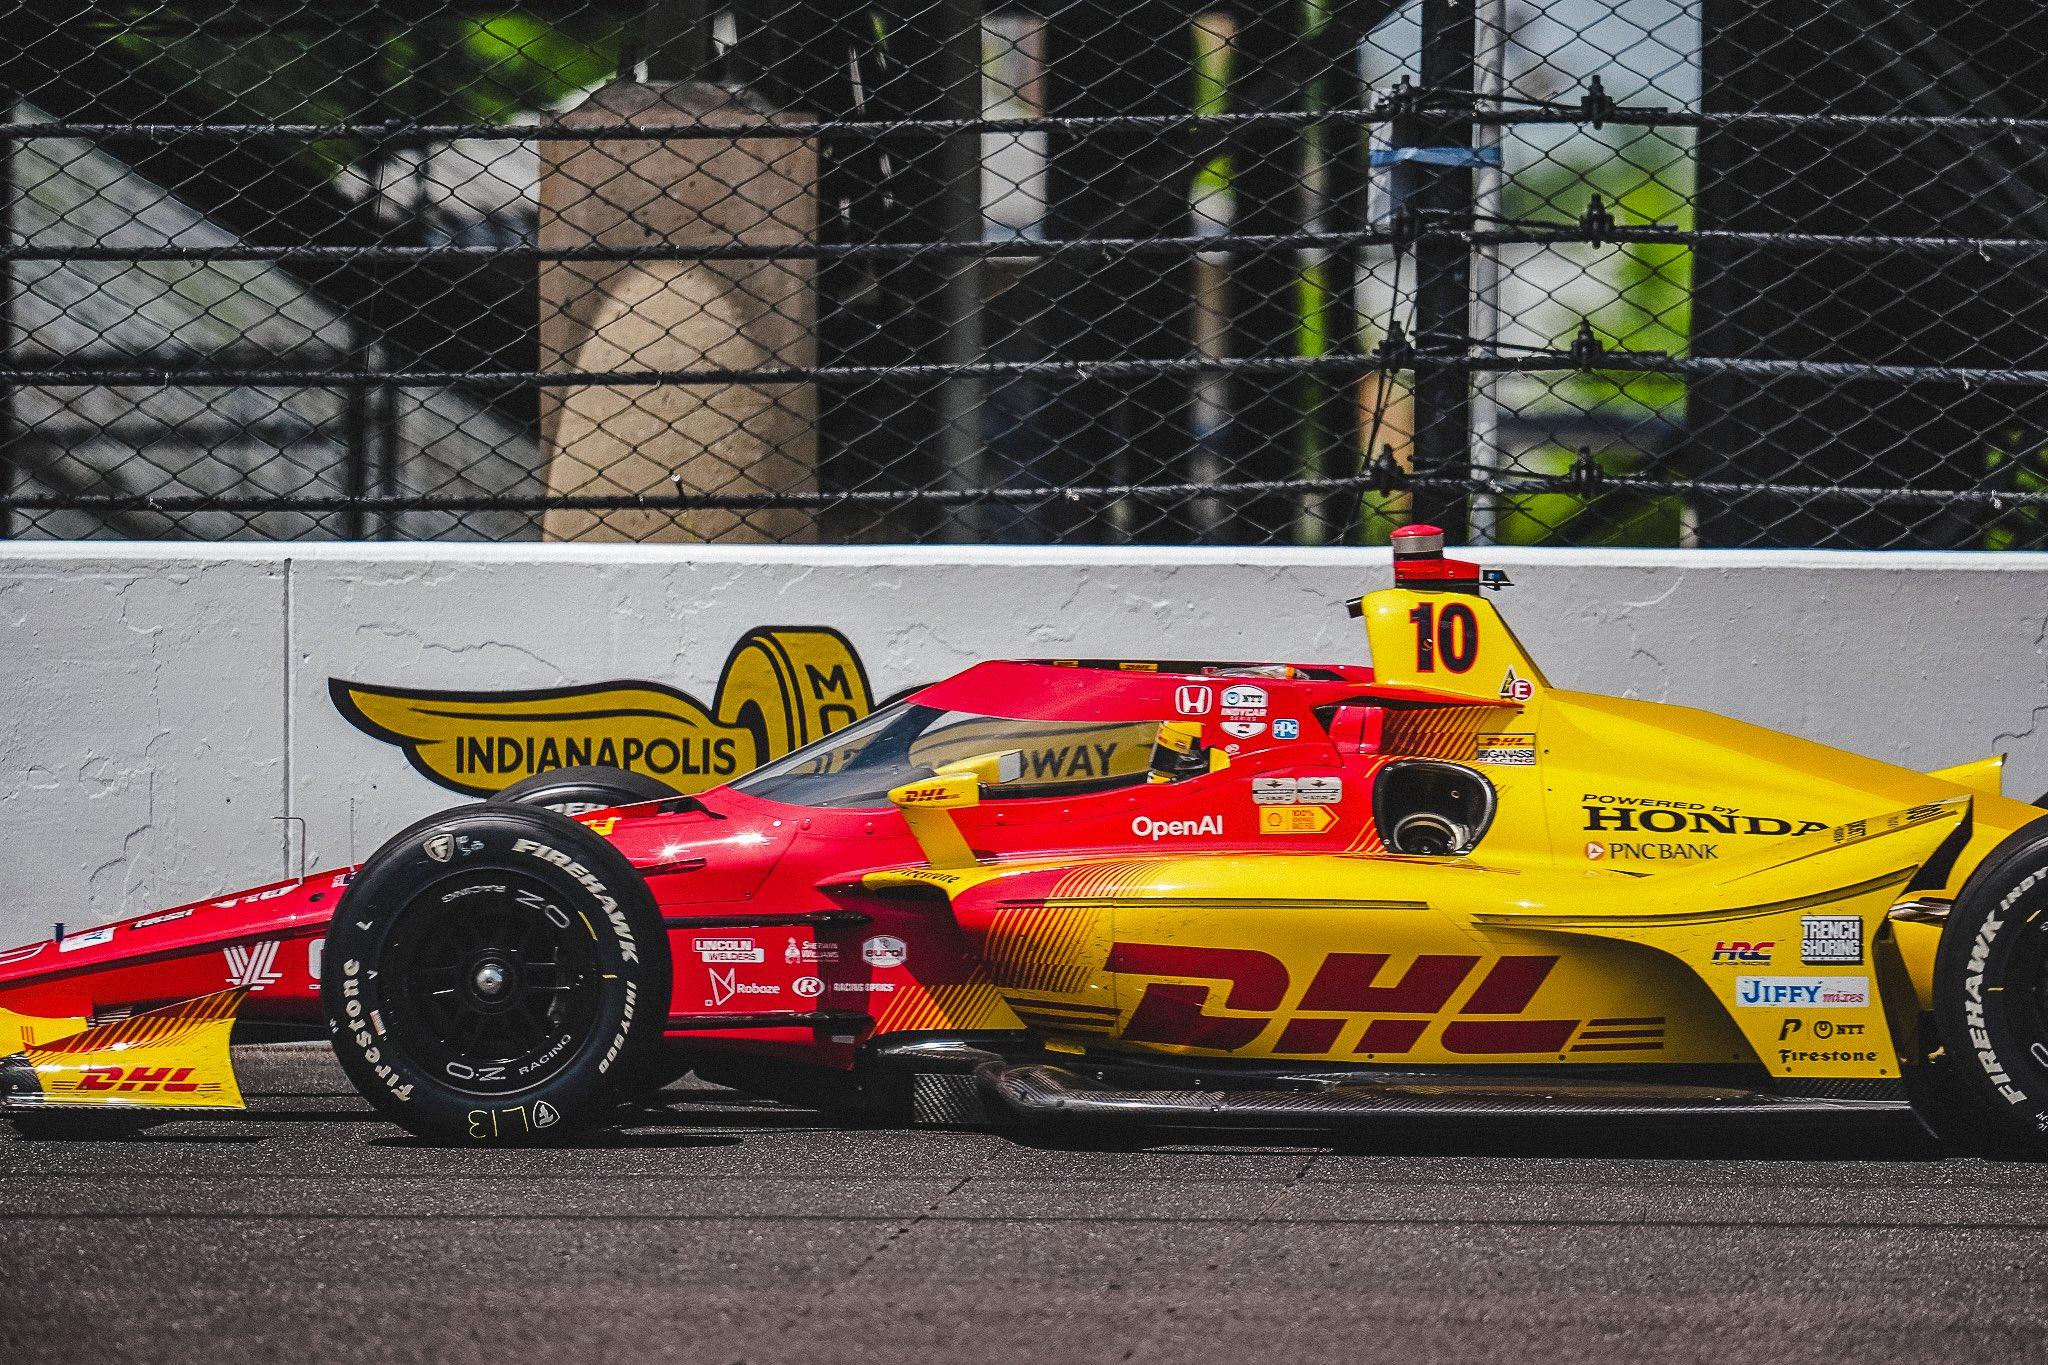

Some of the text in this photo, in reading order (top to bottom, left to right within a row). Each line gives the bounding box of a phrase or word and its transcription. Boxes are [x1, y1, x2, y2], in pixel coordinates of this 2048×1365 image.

[1409, 602, 1479, 673] 10
[456, 737, 737, 775] INDIANAPOLIS
[903, 787, 948, 803] DHL
[1582, 794, 1705, 811] POWERED
[1131, 815, 1223, 841] OpenAI
[1582, 805, 1831, 837] HONDA
[511, 838, 640, 965] FIREHAWK
[1801, 921, 1860, 940] TRENCH
[695, 940, 752, 951] LINCOLN
[708, 952, 757, 961] WELDERS
[1711, 941, 1777, 961] HRC
[1801, 940, 1860, 956] SHORING
[736, 982, 781, 994] Roboze
[1102, 941, 1582, 1055] DHL
[1742, 979, 1822, 1004] JIFFY
[1964, 909, 2028, 1105] FIREHAWK
[343, 958, 414, 1102] Firestone
[1836, 1023, 1865, 1035] NTT
[1779, 1049, 1878, 1064] Firestone
[74, 1066, 200, 1092] DHL
